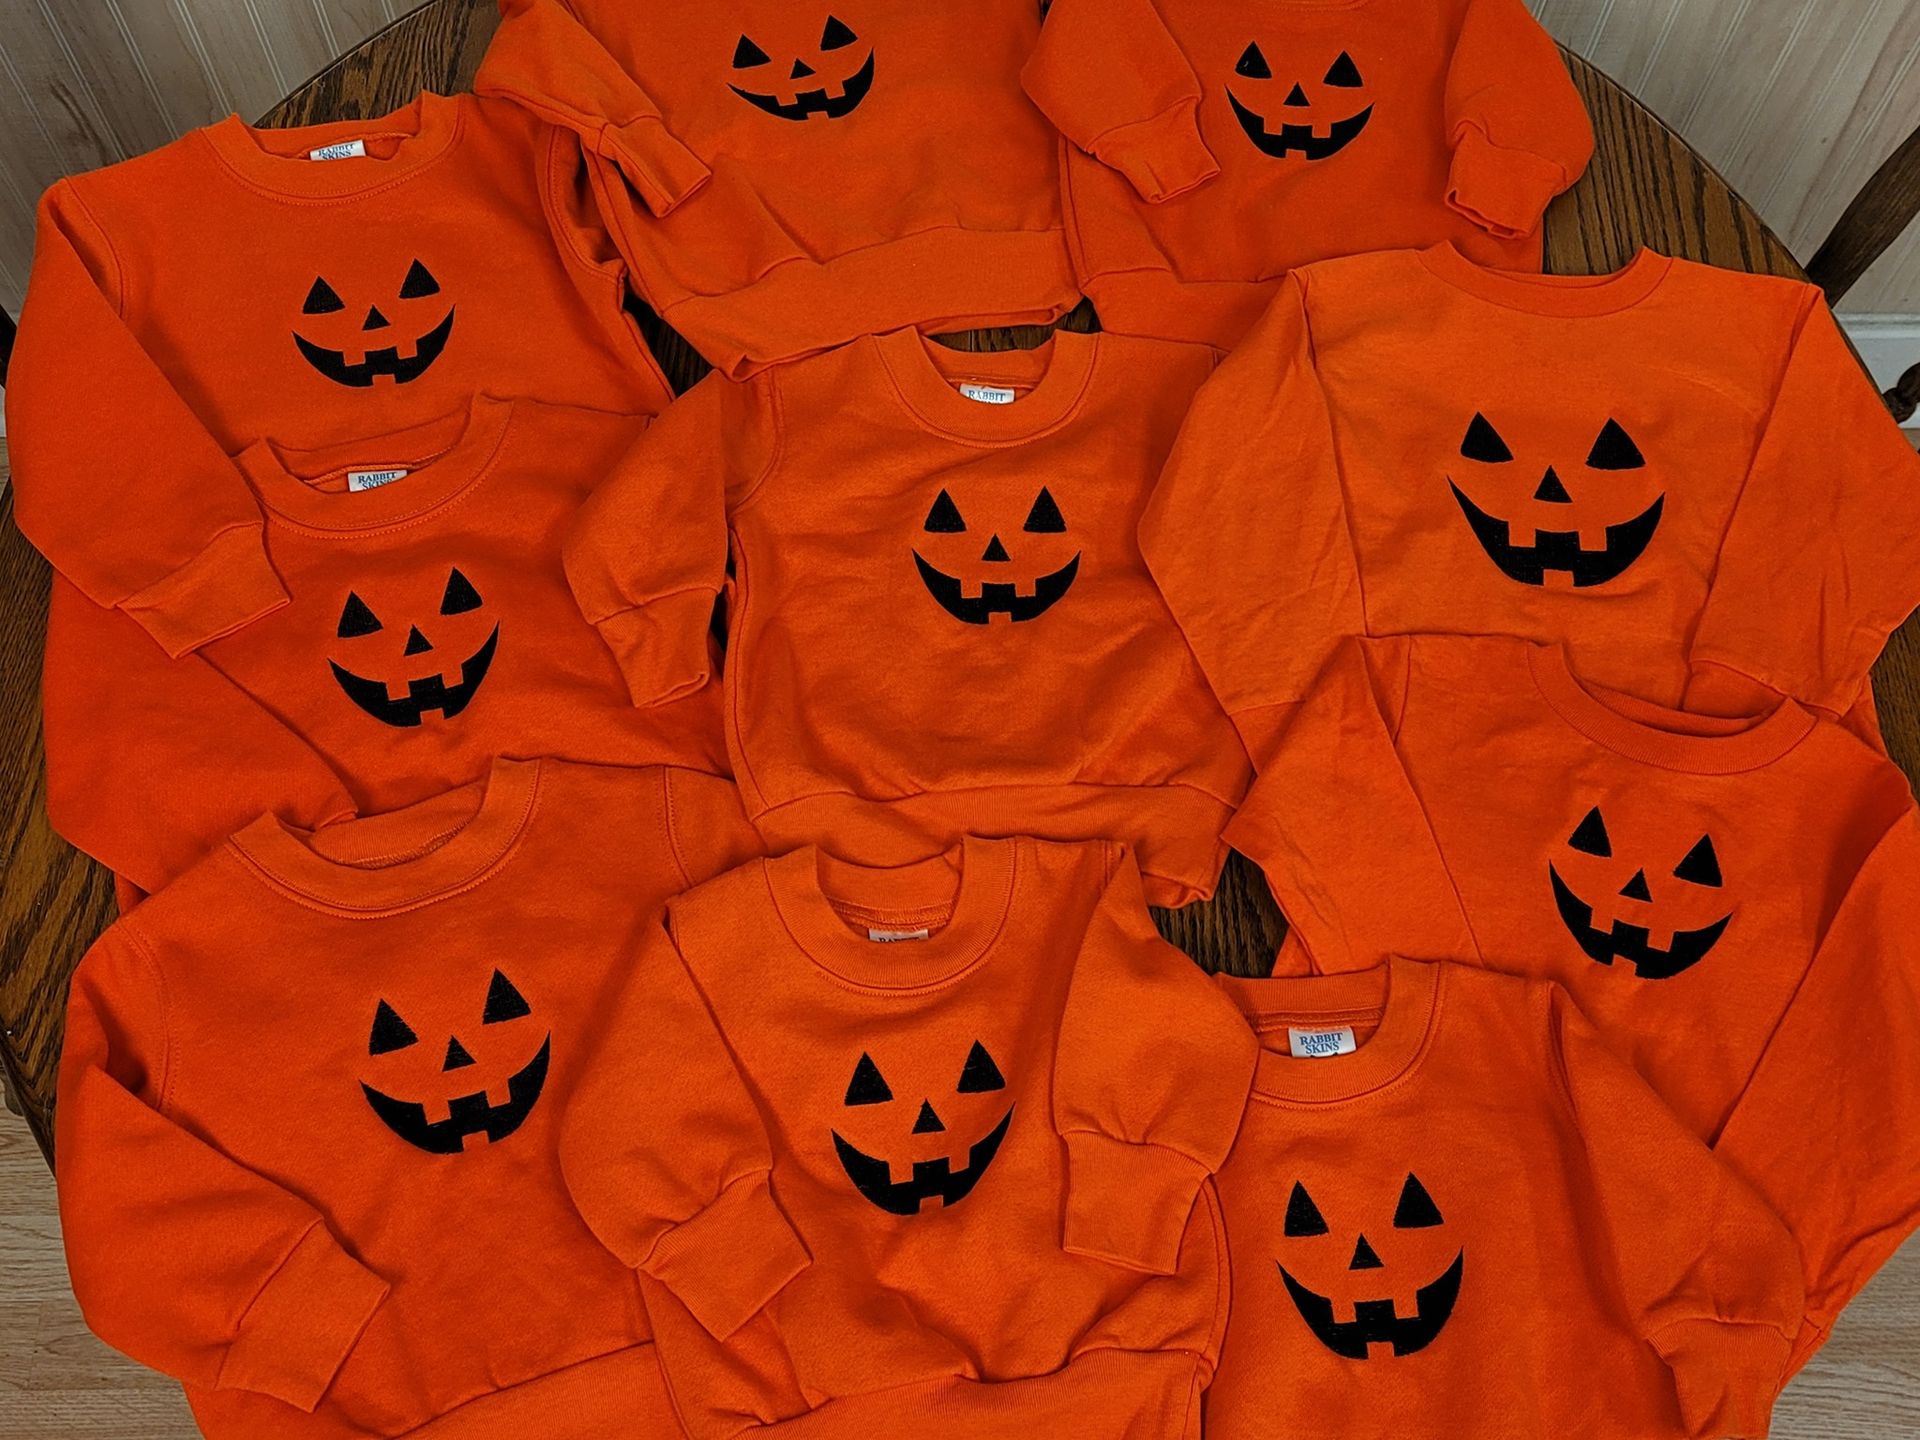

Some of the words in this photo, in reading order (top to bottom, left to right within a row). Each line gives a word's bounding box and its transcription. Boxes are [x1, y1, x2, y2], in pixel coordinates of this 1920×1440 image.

[318, 143, 355, 157] RABBIT
[322, 150, 352, 160] SKINS
[968, 389, 1006, 402] RABBIT
[358, 471, 397, 484] RABBIT
[1299, 1032, 1343, 1046] RABBIT
[1305, 1041, 1340, 1054] SKINS
